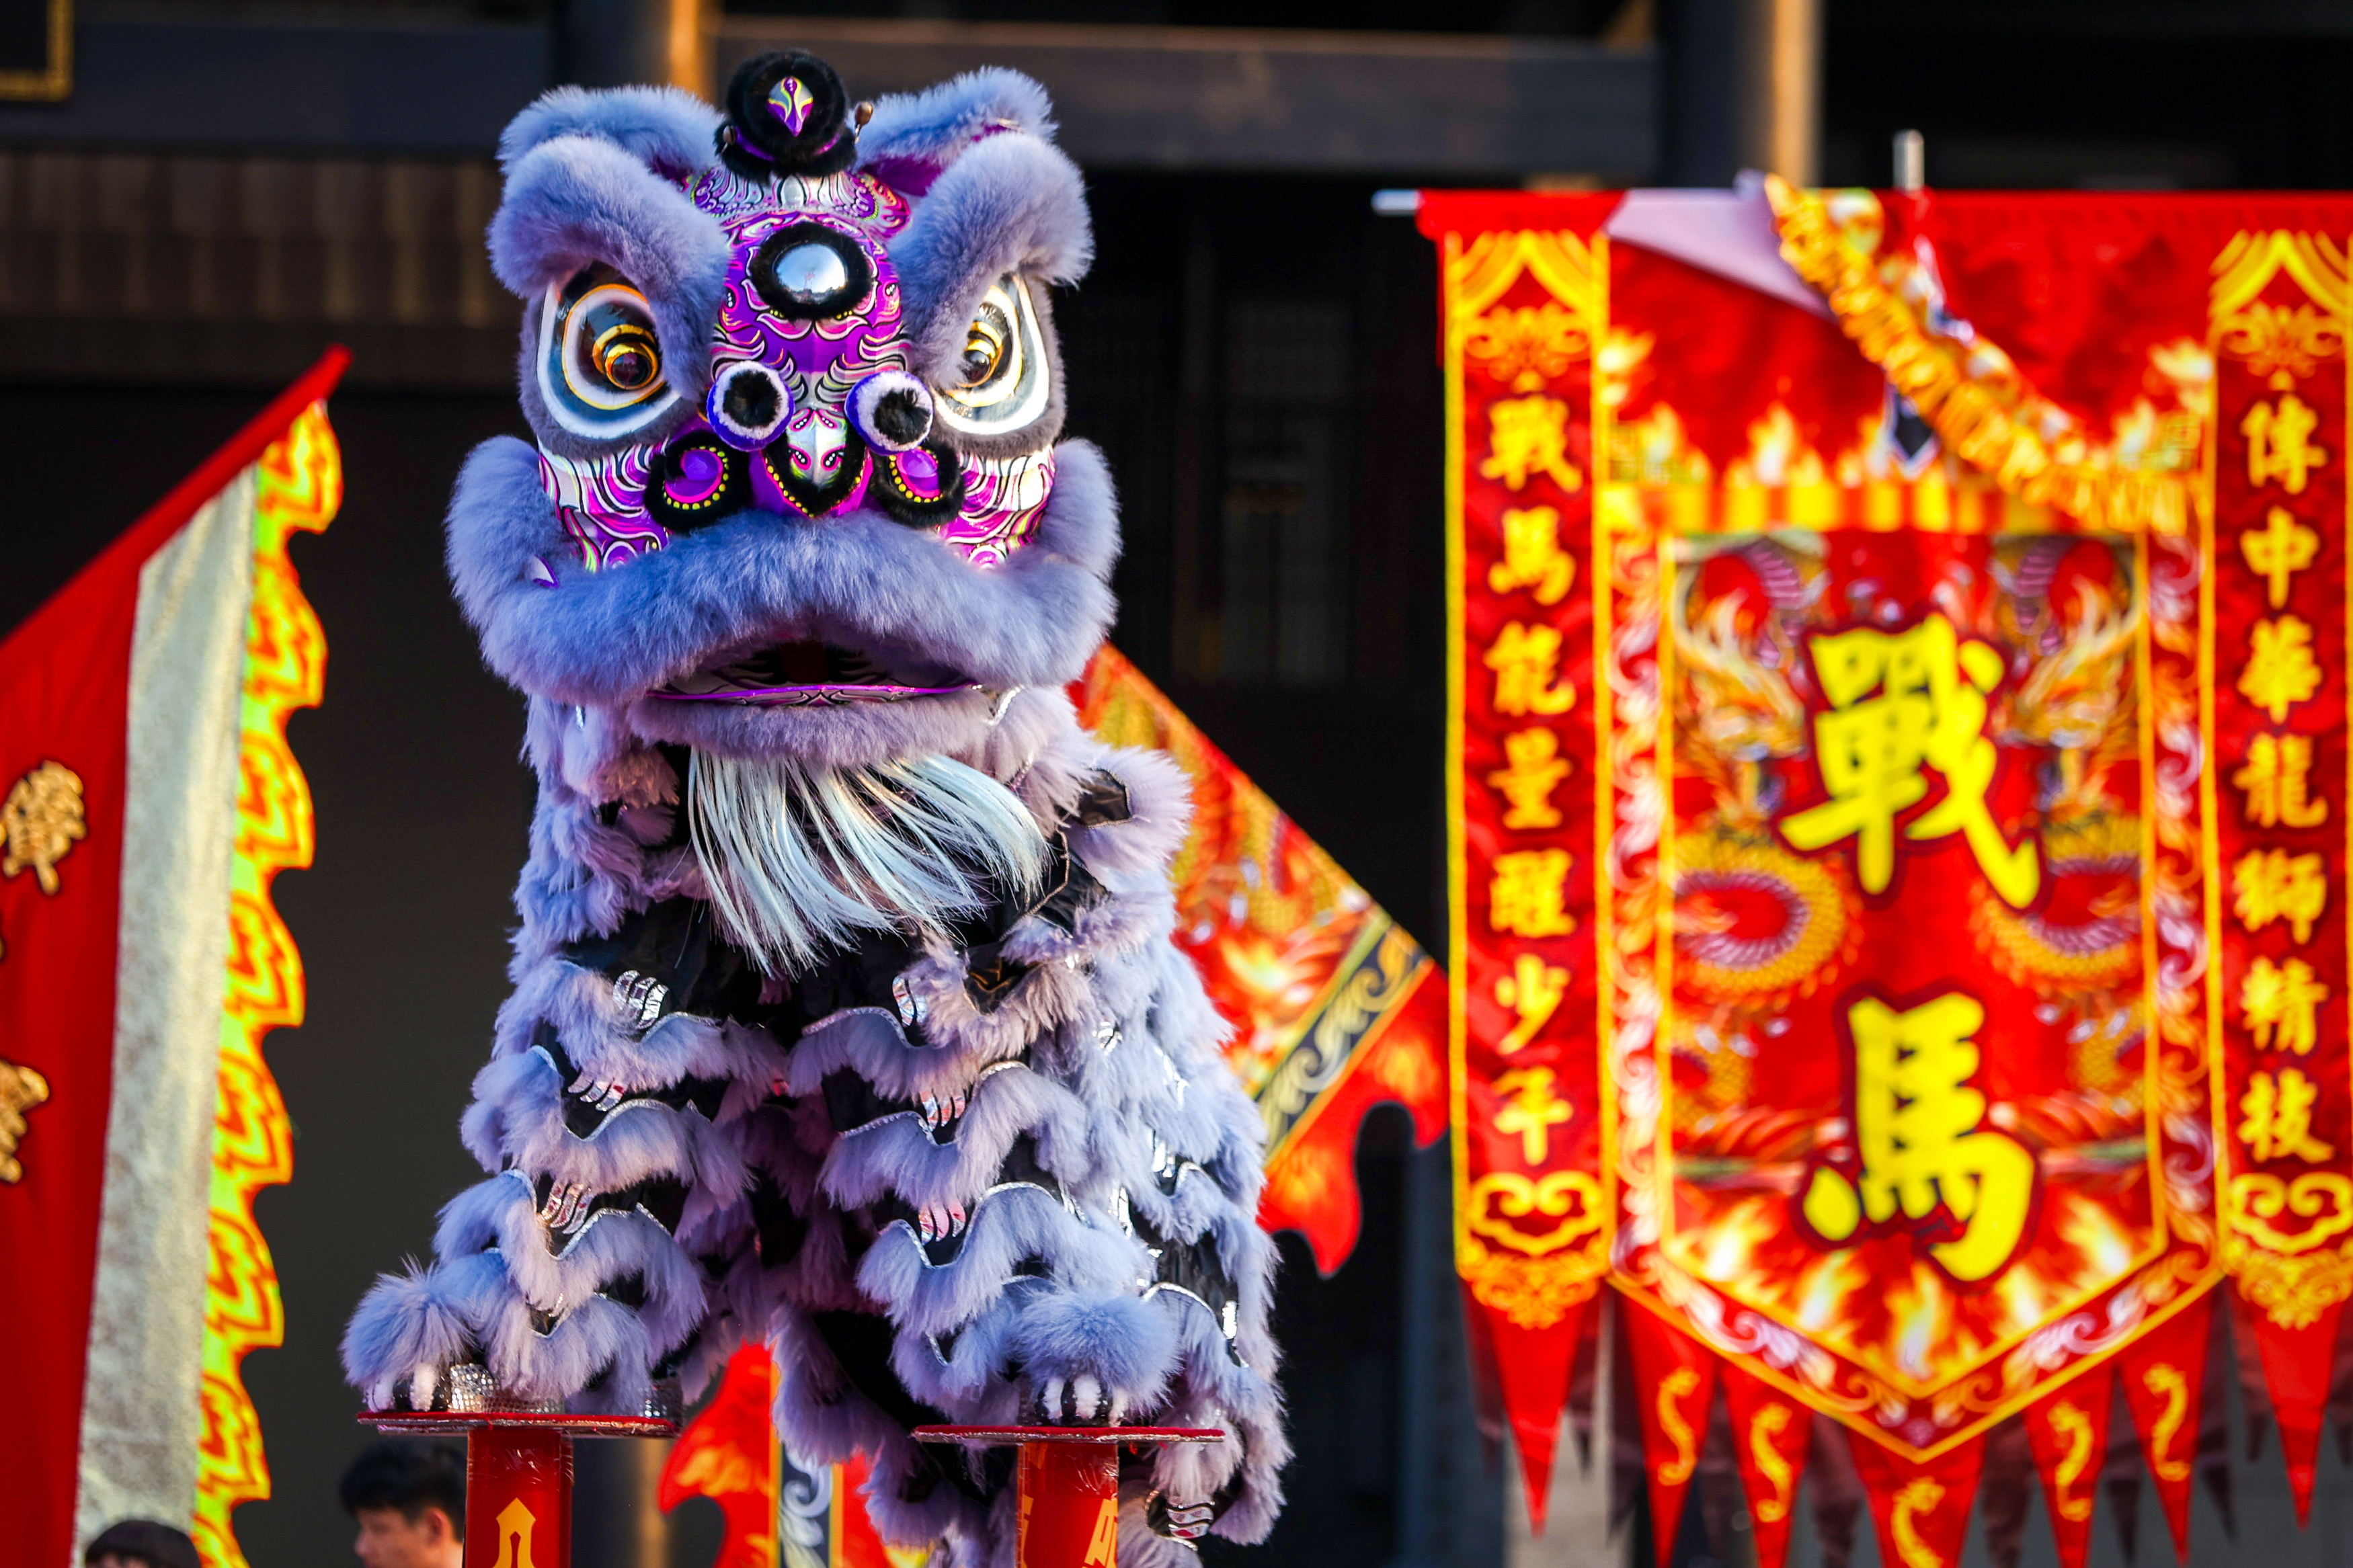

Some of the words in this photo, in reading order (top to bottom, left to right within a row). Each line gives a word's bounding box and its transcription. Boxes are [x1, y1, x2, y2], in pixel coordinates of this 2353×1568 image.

[1777, 613, 2041, 1282] 戰馬
[2231, 394, 2336, 1163] 傳中華龍獅精技
